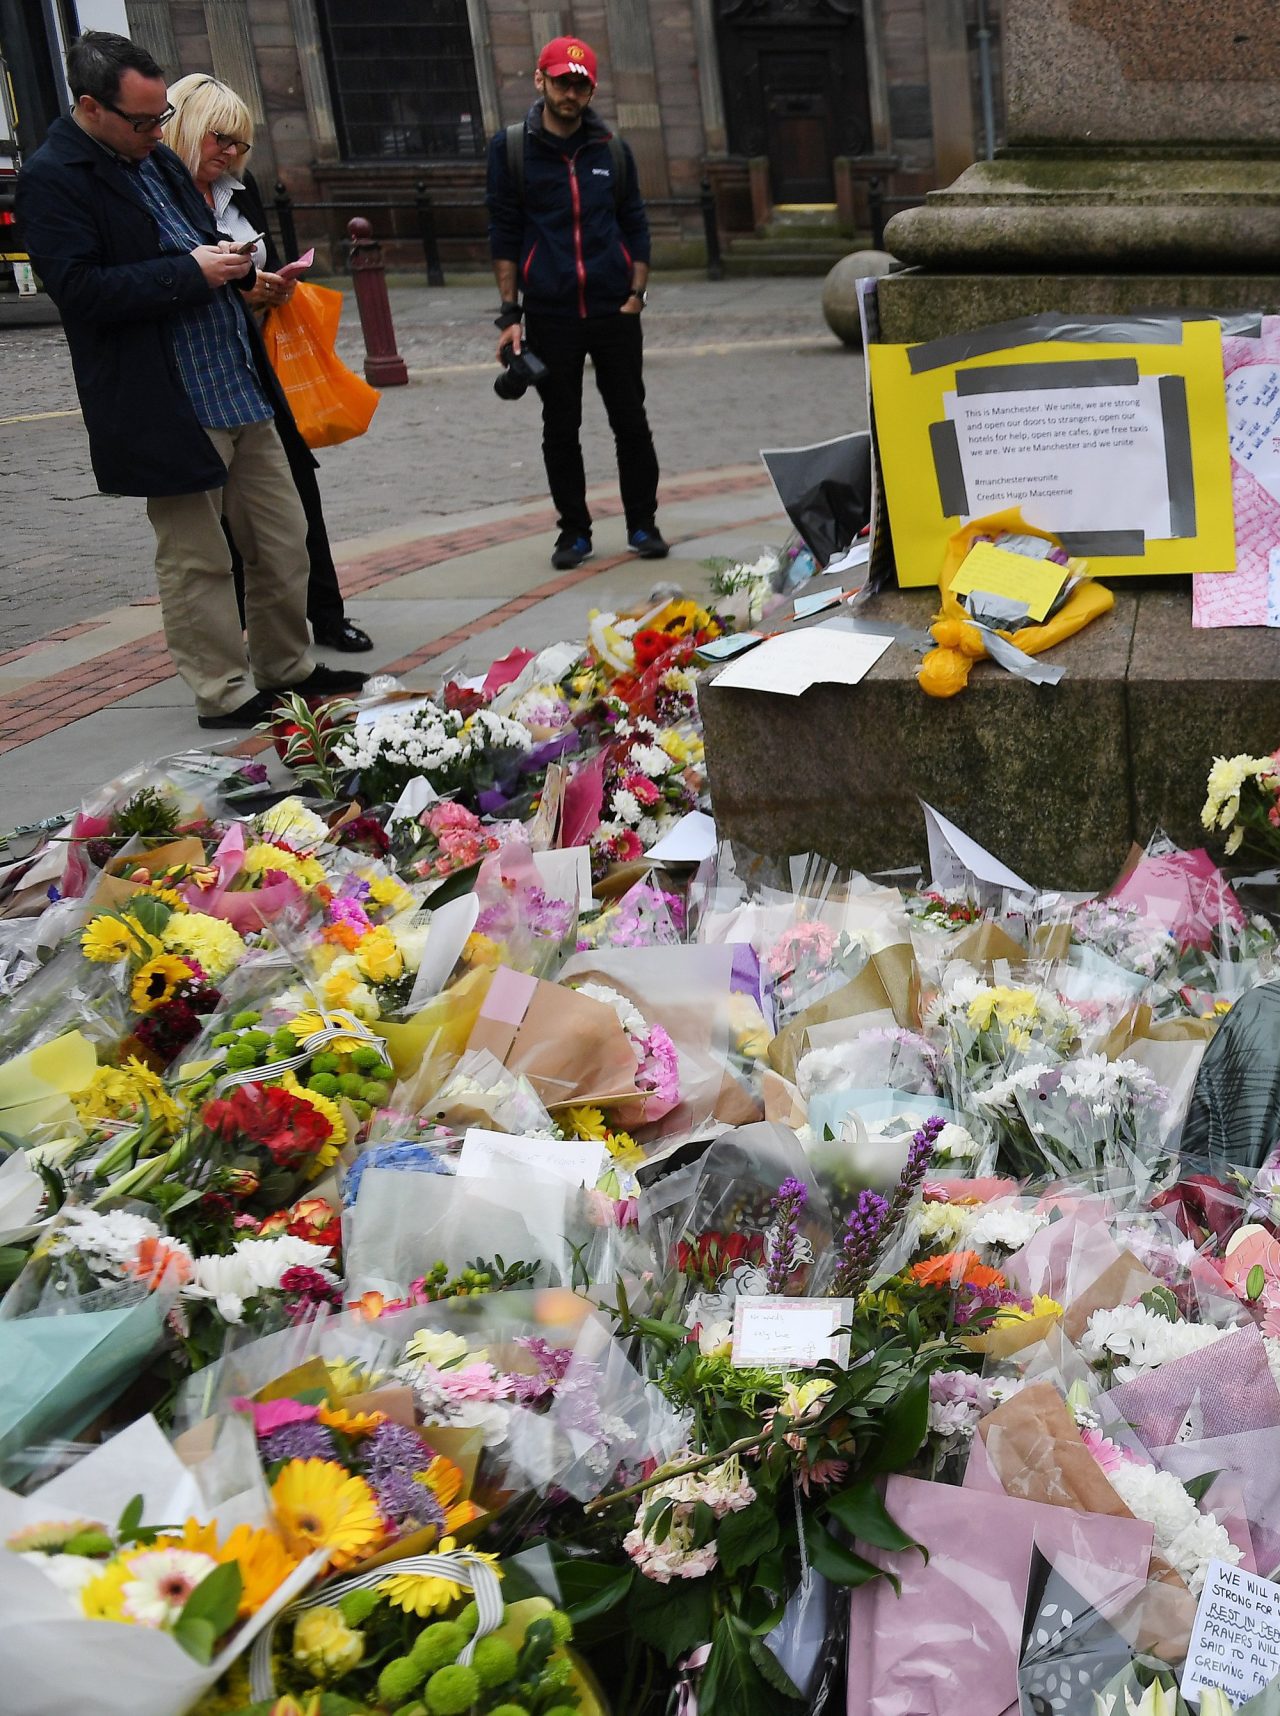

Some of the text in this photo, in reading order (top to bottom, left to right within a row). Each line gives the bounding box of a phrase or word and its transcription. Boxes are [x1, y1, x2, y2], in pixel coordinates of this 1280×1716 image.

[965, 409, 982, 418] This
[1044, 403, 1058, 411] We
[1114, 399, 1140, 408] strong
[967, 422, 982, 431] and
[984, 421, 1005, 430] open
[1022, 418, 1046, 426] doors
[1048, 417, 1056, 425] to
[1099, 414, 1120, 422] open
[968, 434, 994, 443] hotels
[995, 433, 1007, 441] for
[1031, 431, 1052, 440] open
[1093, 428, 1110, 436] give
[1111, 425, 1128, 433] free
[1129, 425, 1149, 433] taxis
[1002, 446, 1016, 454] We
[1018, 445, 1031, 453] are
[1032, 441, 1080, 452] Manchester
[1082, 441, 1097, 449] and
[1113, 439, 1134, 447] unite
[976, 492, 1005, 501] Credits
[1006, 491, 1028, 500] Hugo
[1219, 1567, 1241, 1587] WE
[1247, 1580, 1269, 1599] WILL
[1211, 1583, 1253, 1609] STRONG
[1255, 1602, 1273, 1616] FOR
[1209, 1602, 1241, 1621] REST
[1244, 1616, 1256, 1628] IN
[1203, 1620, 1254, 1649] PRAYERS
[1257, 1640, 1280, 1657] WILL
[1199, 1637, 1226, 1656] SAID
[1231, 1648, 1246, 1660] TO
[1250, 1654, 1270, 1669] ALL
[1194, 1655, 1245, 1681] GREIVING
